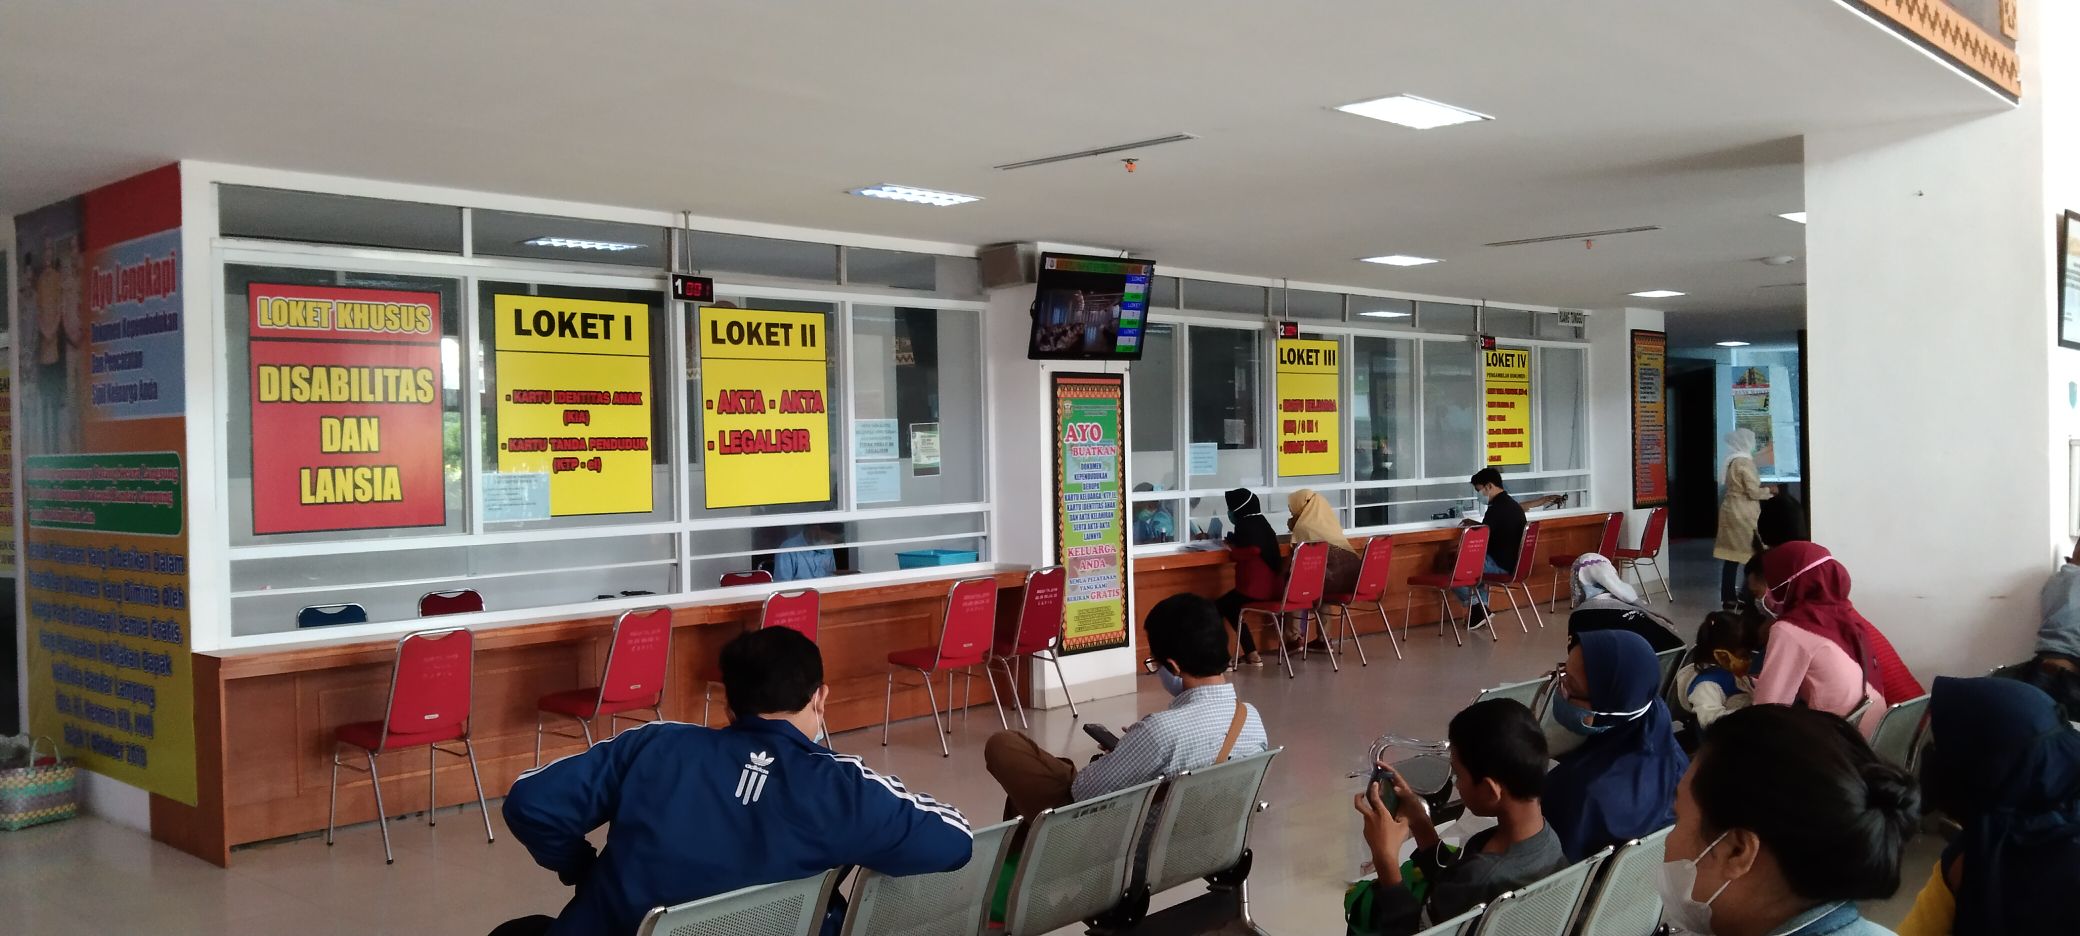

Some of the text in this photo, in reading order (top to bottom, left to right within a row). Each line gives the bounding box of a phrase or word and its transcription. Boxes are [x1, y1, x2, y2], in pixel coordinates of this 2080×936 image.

[91, 251, 176, 310] Ayo Lengkapi
[675, 278, 682, 294] 1
[257, 296, 432, 334] LOKET KHUSUS
[514, 309, 632, 341] LOKET I
[711, 320, 816, 347] LOKET II
[1279, 347, 1336, 366] LOKET III
[1486, 352, 1527, 368] LOKET IV
[258, 364, 435, 404] DISABILITAS
[512, 390, 552, 405] KARTU
[717, 389, 765, 414] AKTA
[779, 389, 825, 414] AKTA
[321, 415, 380, 454] DAN
[719, 429, 811, 455] LEGALISIR
[1064, 423, 1103, 443] AYO
[508, 437, 648, 452] KARTU TANDA PENDUDUK
[1072, 445, 1116, 458] BUATKAN
[1081, 462, 1102, 471] DOKUMEN
[300, 466, 403, 505] LANSIA
[1067, 544, 1117, 558] KELUARGA
[1080, 558, 1106, 570] ANDA
[1080, 583, 1095, 592] YANG
[1090, 588, 1121, 601] GRATIS
